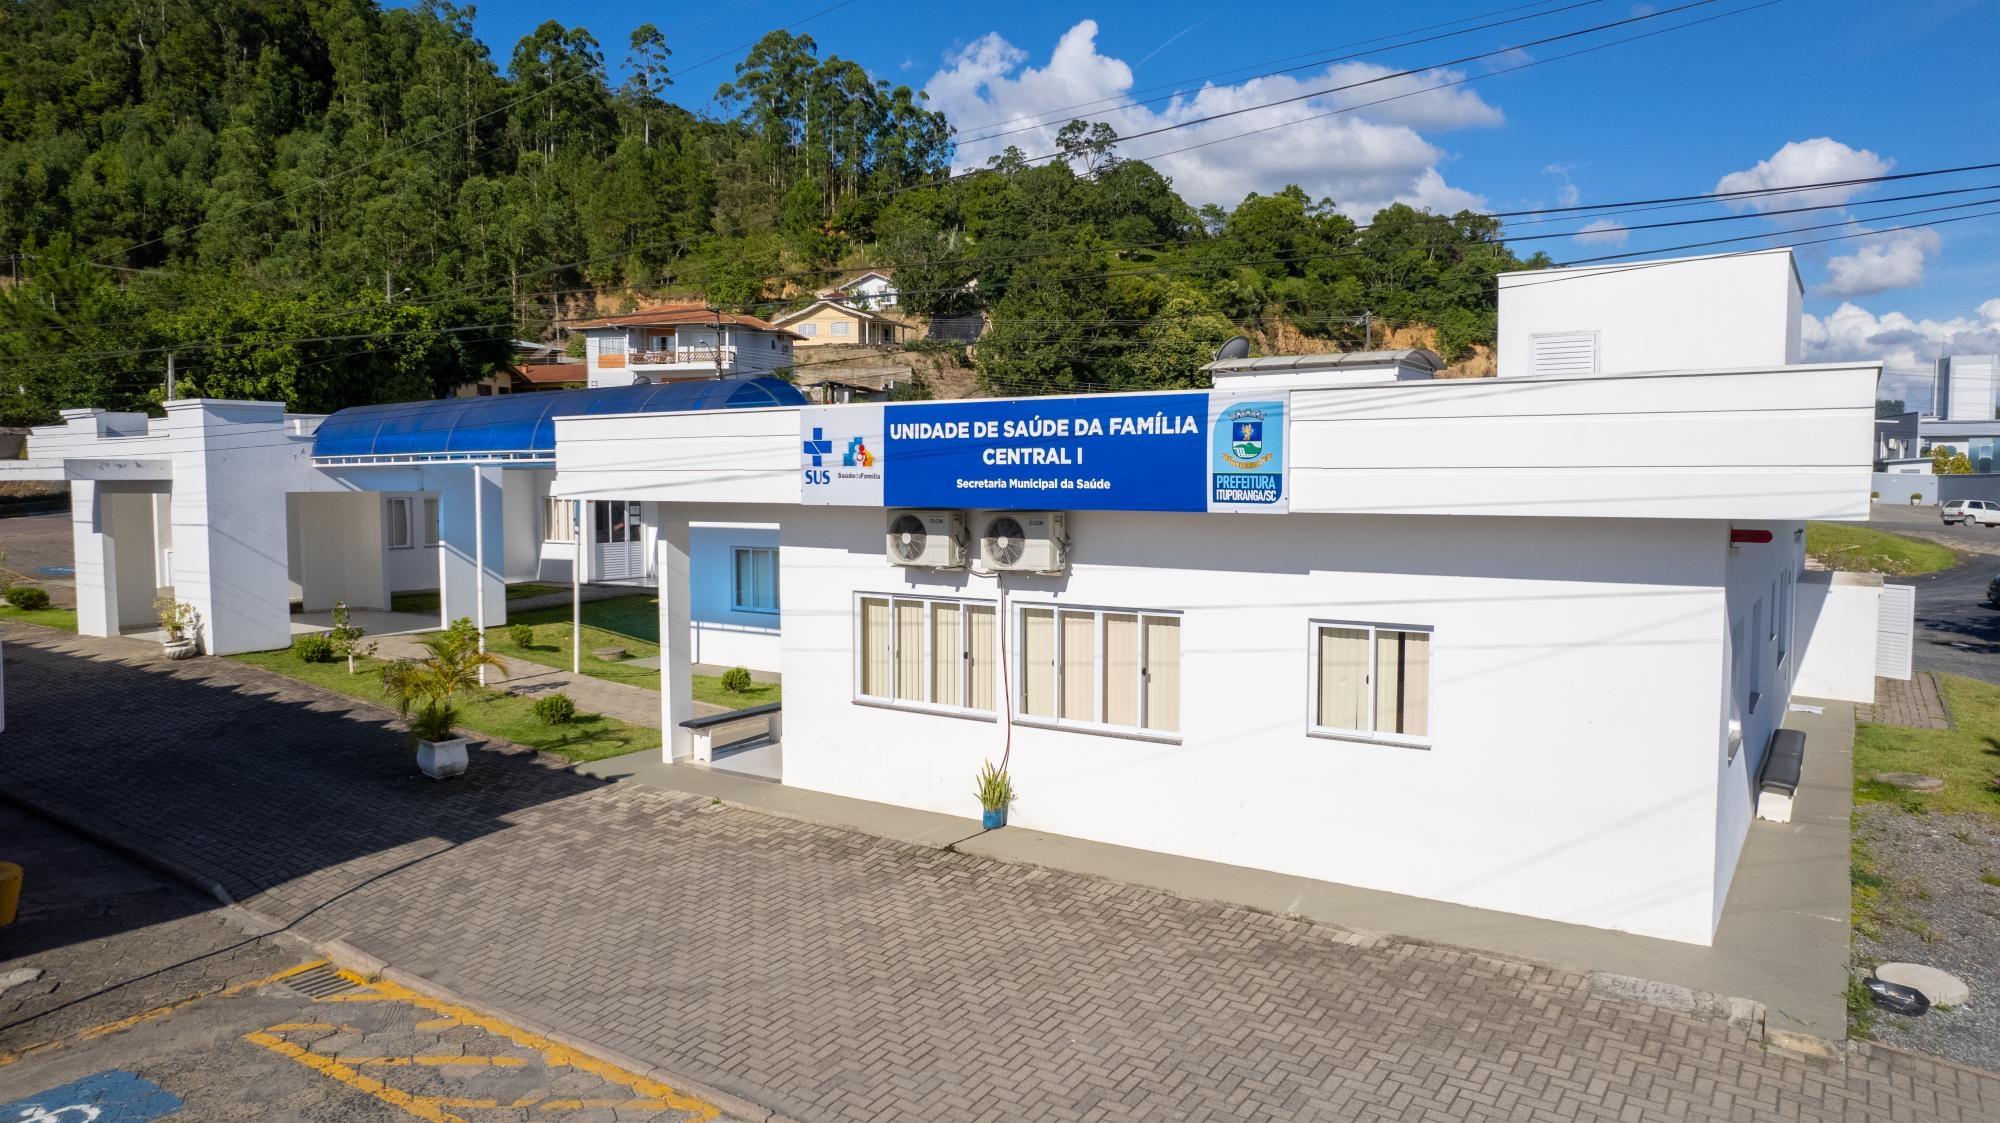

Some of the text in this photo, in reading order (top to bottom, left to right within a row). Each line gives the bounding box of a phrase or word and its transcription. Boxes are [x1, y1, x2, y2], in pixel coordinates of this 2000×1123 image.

[890, 411, 1199, 440] UNIDADE DE SAÚDE DA FAMÍLIA
[982, 447, 1083, 465] CENTRAL I
[805, 470, 830, 485] SUS
[956, 478, 1111, 491] Secretaria Municipal da Saúde
[1216, 474, 1276, 490] PREFEITURA
[1216, 489, 1277, 501] ITUPORANGA/SC
